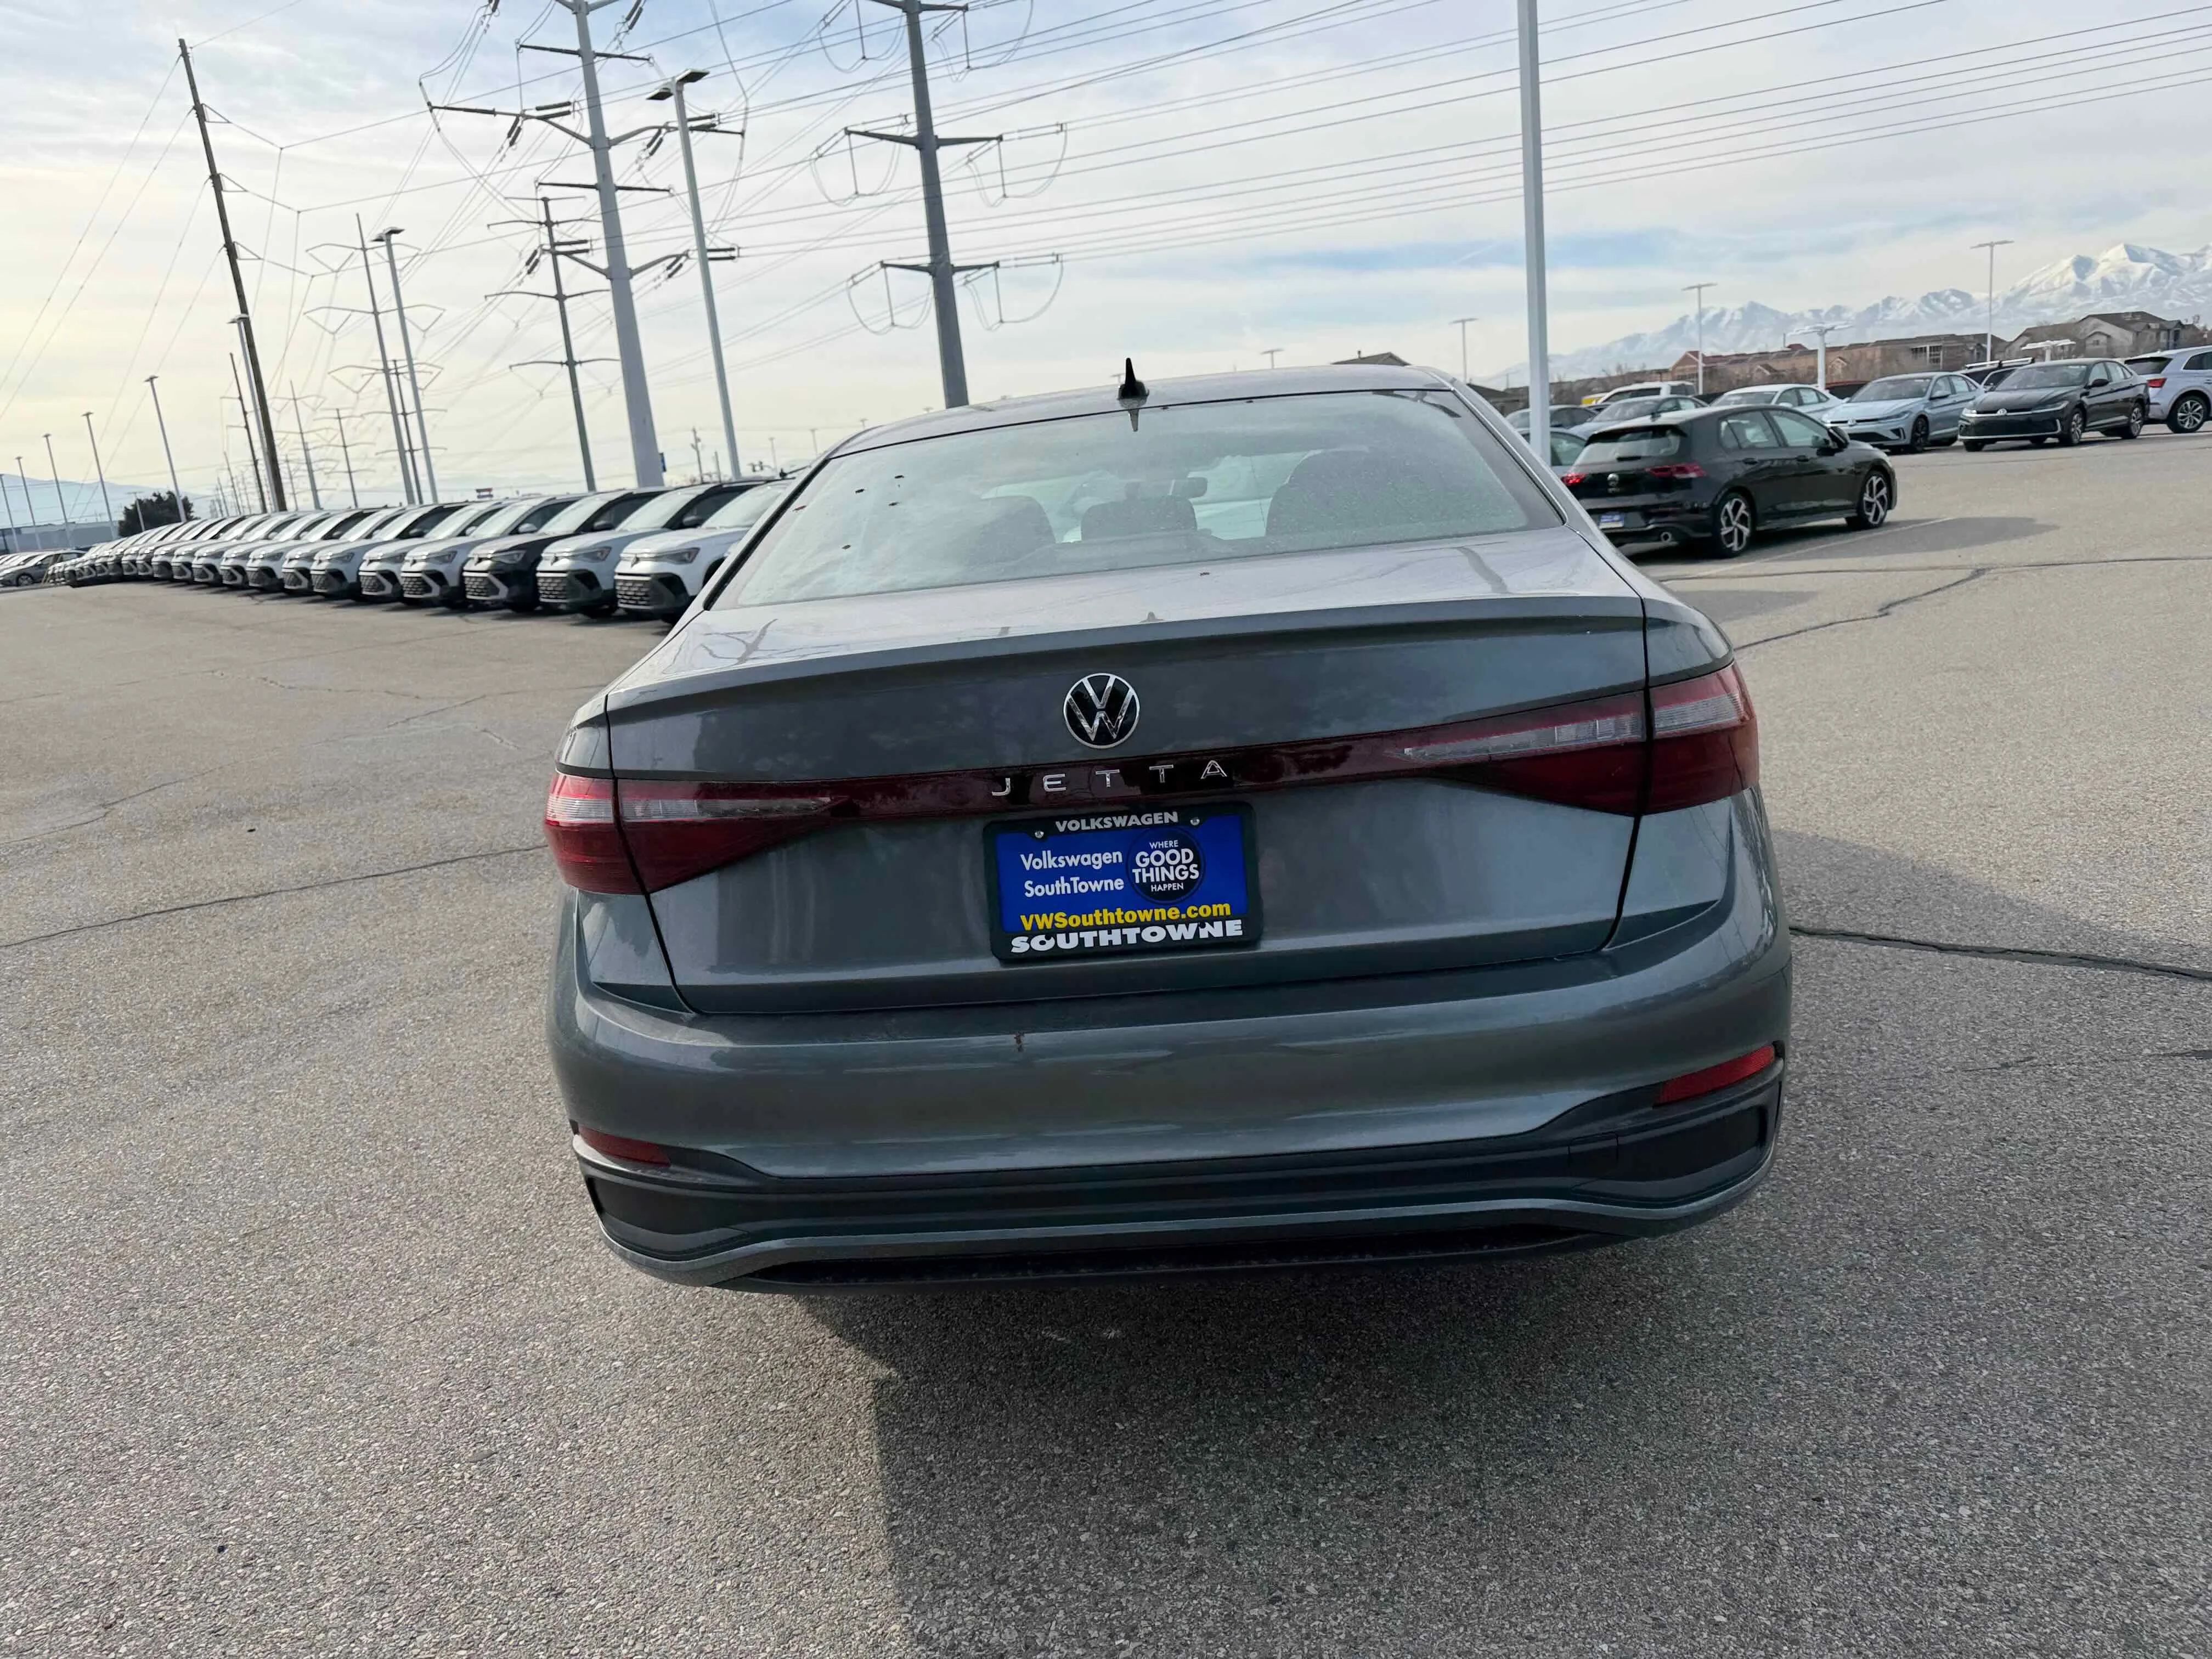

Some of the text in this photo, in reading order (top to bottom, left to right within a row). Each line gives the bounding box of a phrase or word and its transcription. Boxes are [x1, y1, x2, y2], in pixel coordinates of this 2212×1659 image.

[991, 760, 1228, 796] JETTA
[1056, 811, 1178, 832] VOLKSWAGEN
[1149, 840, 1178, 849] WHERE
[1020, 850, 1122, 871] Volkswagen
[1135, 848, 1194, 868] GOOD
[1132, 864, 1199, 884] THINGS
[1024, 876, 1124, 897] SouthTowne
[1151, 882, 1184, 893] HAPPEN
[1020, 903, 1231, 930] VWSouthtowne.com
[1011, 919, 1243, 953] SOUTHTOWNE
